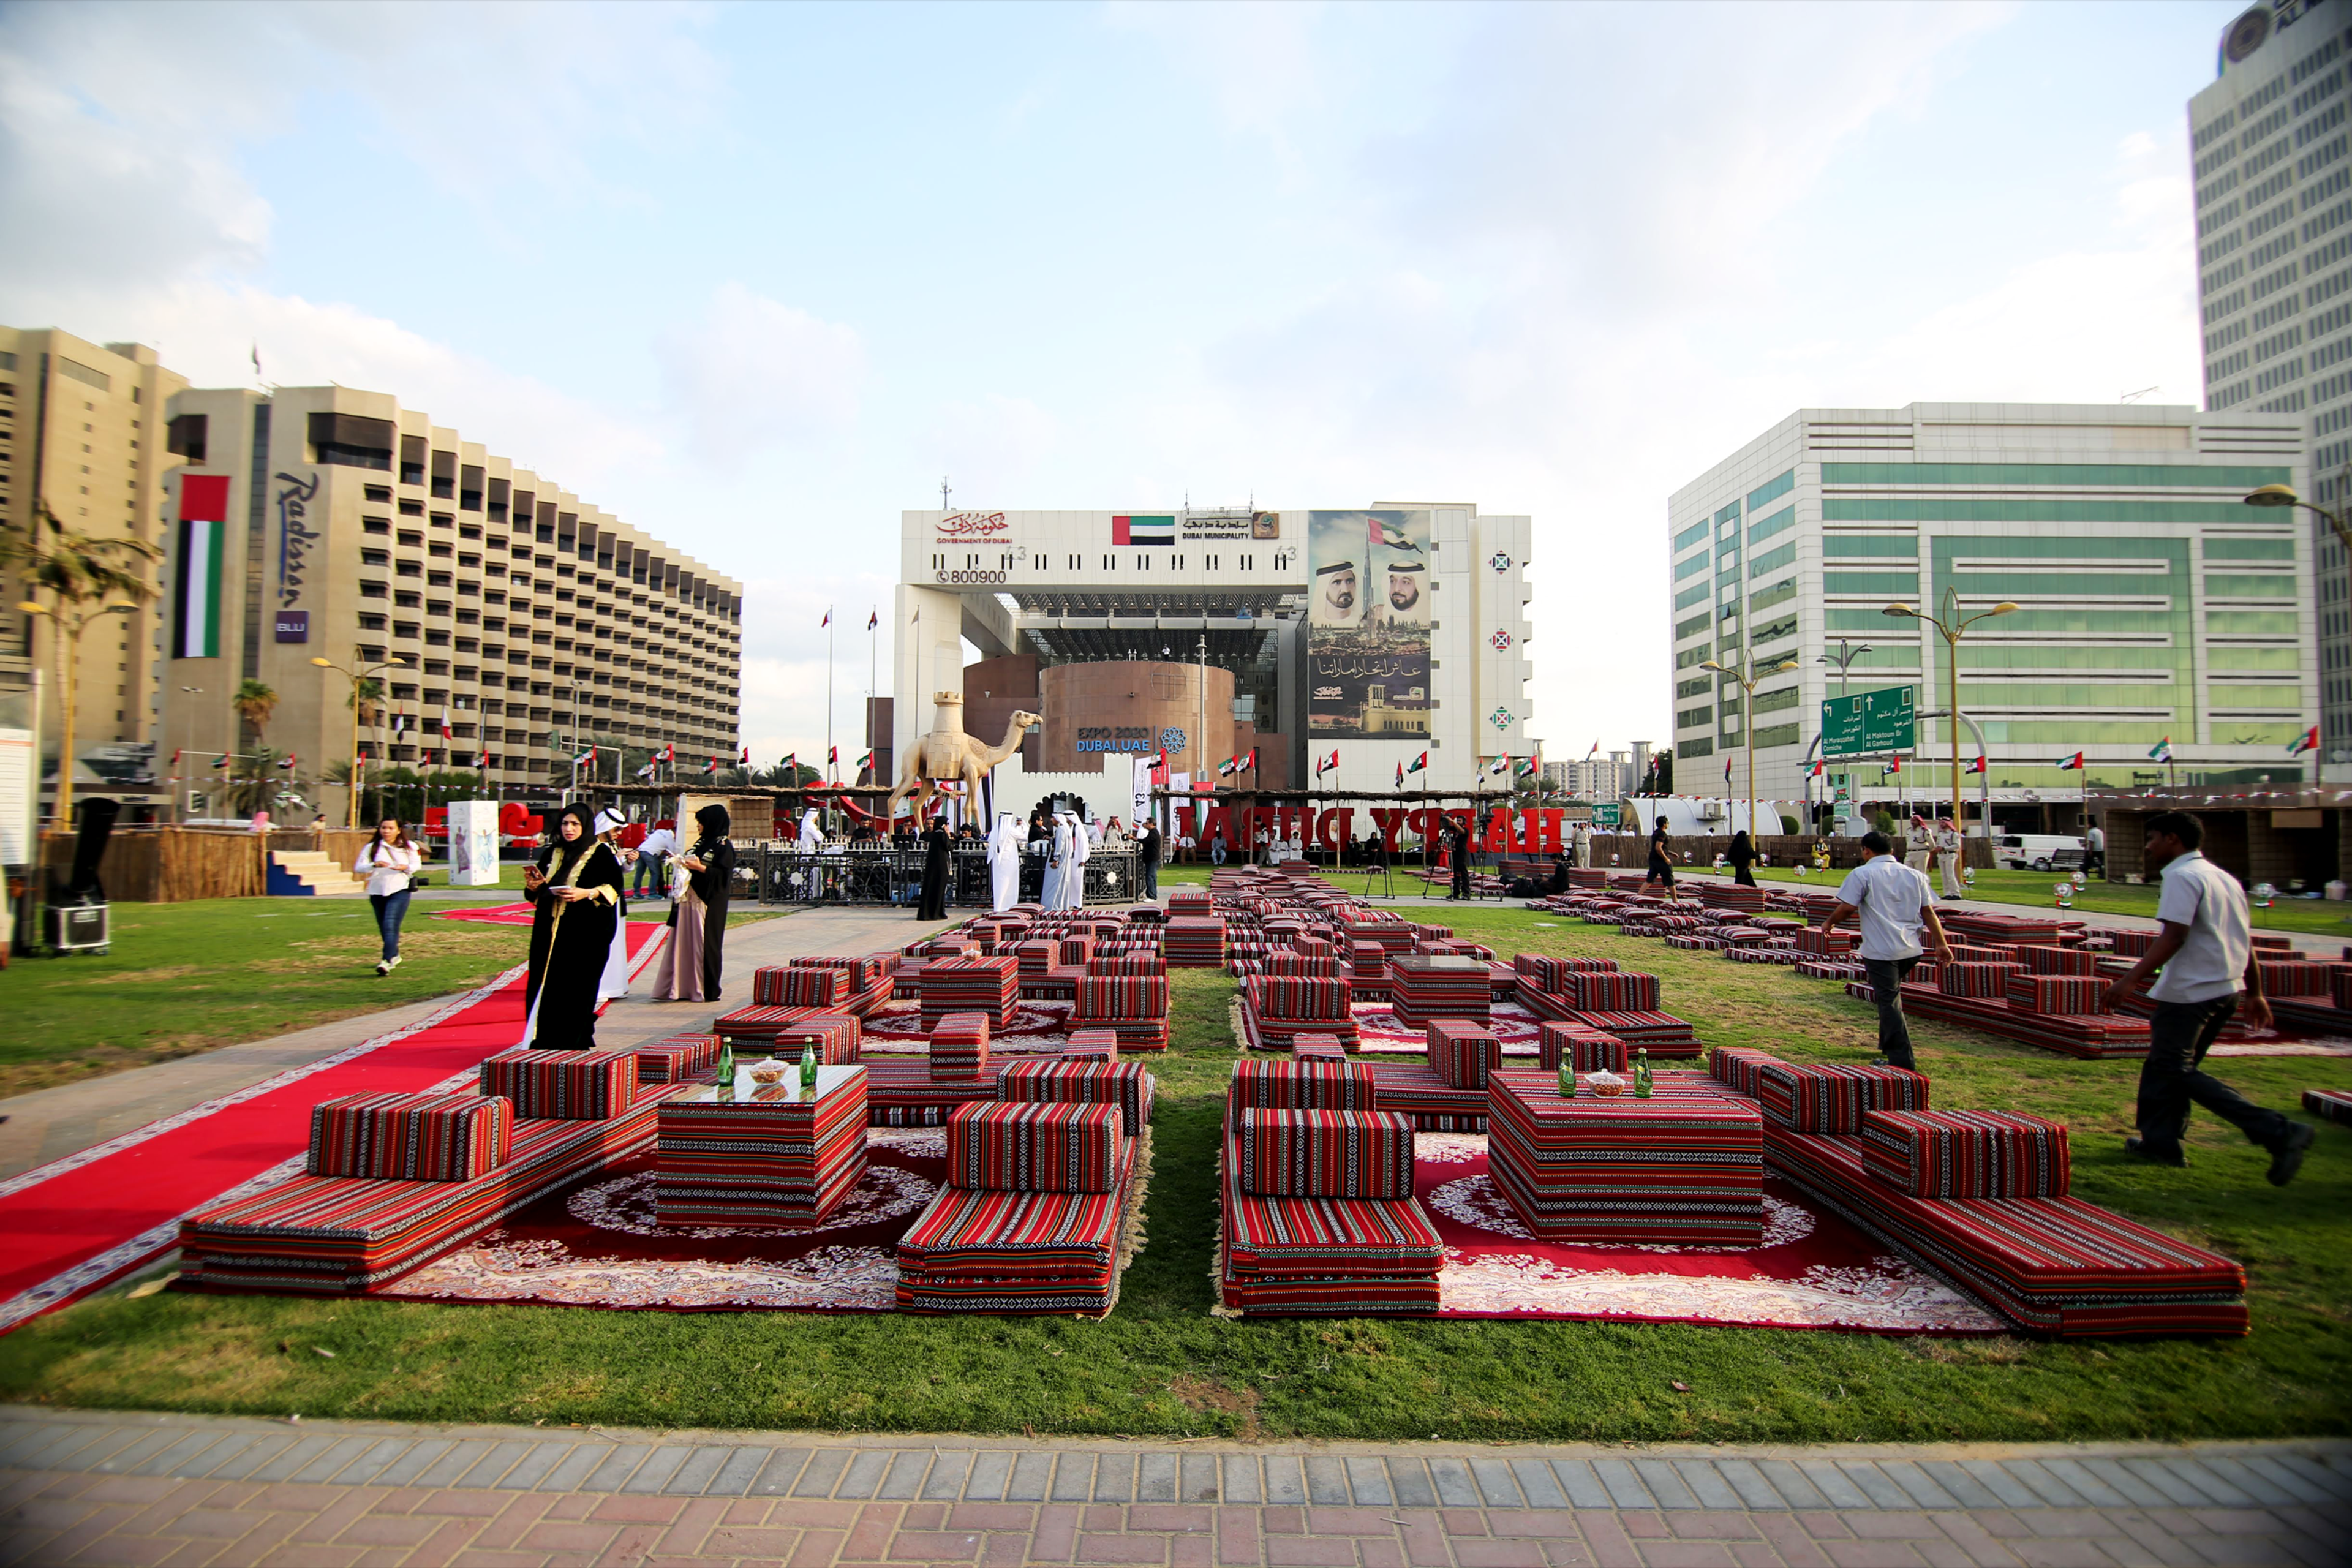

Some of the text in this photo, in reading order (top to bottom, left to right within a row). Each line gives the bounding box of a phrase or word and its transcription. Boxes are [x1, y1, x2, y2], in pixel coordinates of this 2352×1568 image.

[275, 472, 321, 608] Radisson
[951, 570, 1006, 584] 800900
[276, 622, 305, 632] BLU
[1077, 726, 1150, 739] EXPO 2020
[1076, 740, 1151, 753] DUBAI, UAE
[1872, 739, 1893, 748] Garhoud
